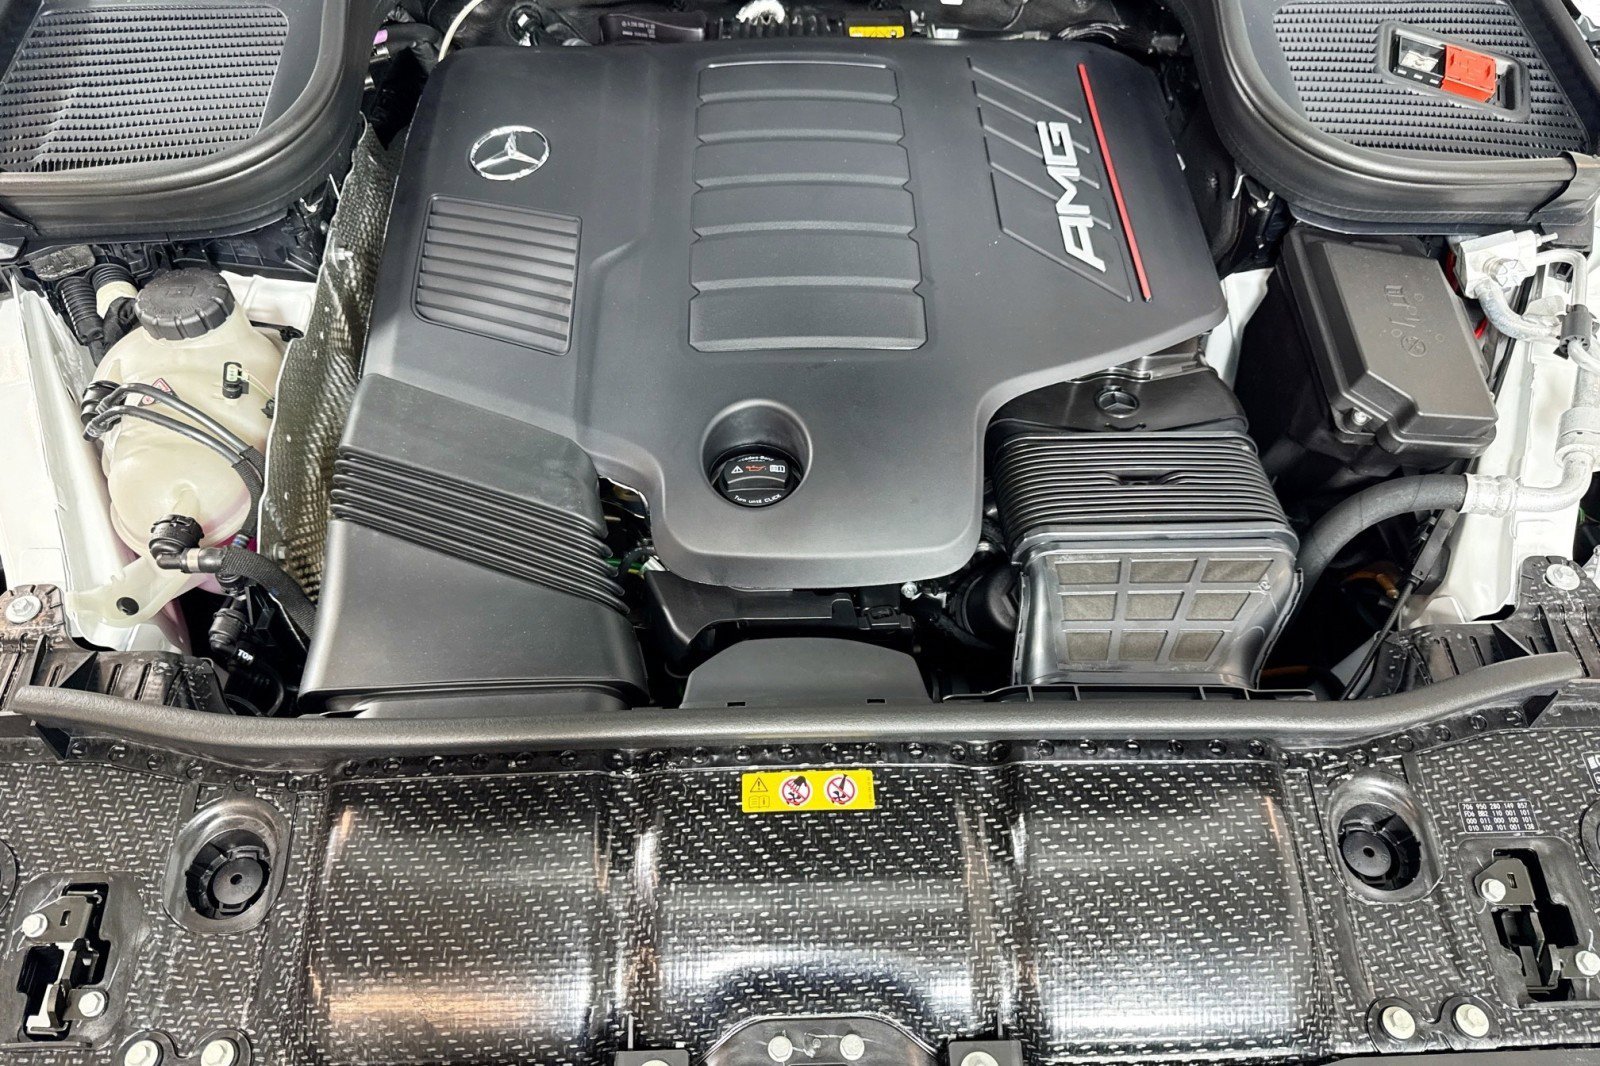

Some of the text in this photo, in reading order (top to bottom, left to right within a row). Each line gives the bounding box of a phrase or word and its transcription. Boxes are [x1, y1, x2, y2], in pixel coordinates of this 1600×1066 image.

[1037, 121, 1106, 272] AMG
[734, 494, 746, 502] Turn
[764, 494, 782, 502] CLICK
[238, 648, 254, 662] TOP
